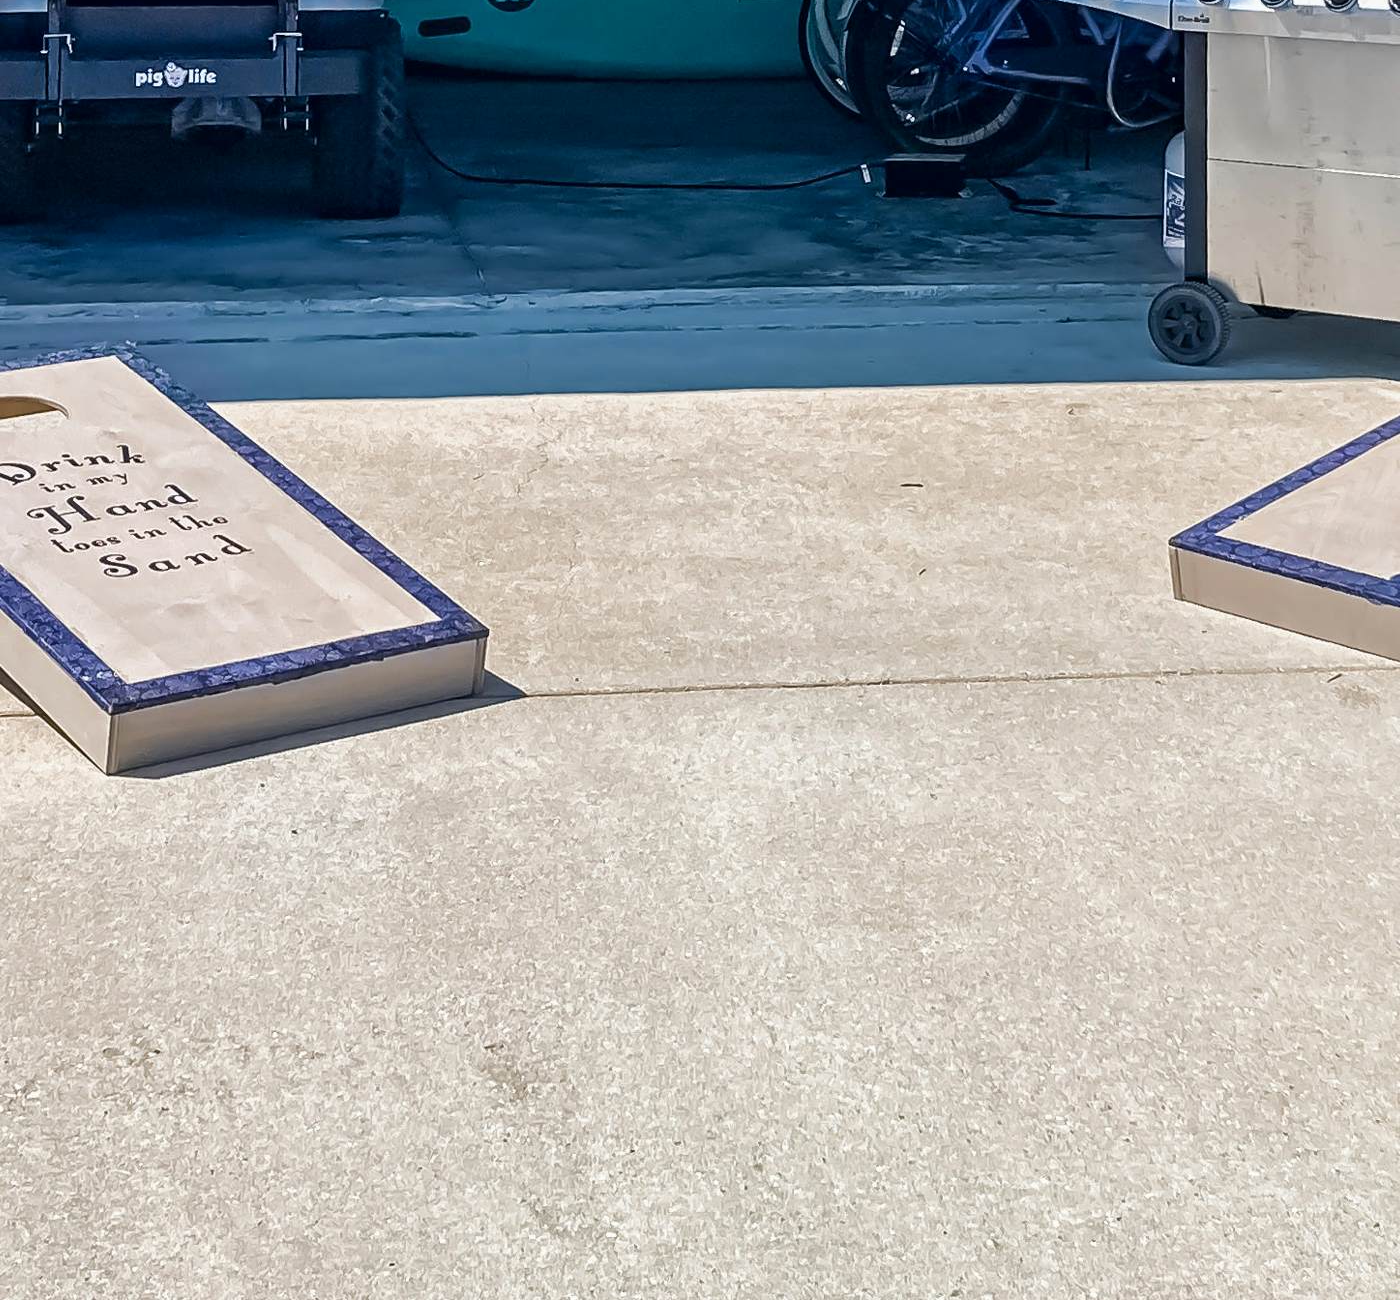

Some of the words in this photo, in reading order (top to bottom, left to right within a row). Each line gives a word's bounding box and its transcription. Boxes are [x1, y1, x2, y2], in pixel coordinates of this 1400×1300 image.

[135, 68, 164, 87] pig
[187, 68, 217, 84] life
[0, 444, 145, 486] Drink
[39, 481, 76, 493] in
[86, 472, 128, 486] my
[26, 484, 199, 535] Hand
[128, 528, 167, 540] in
[99, 534, 252, 577] Sand
